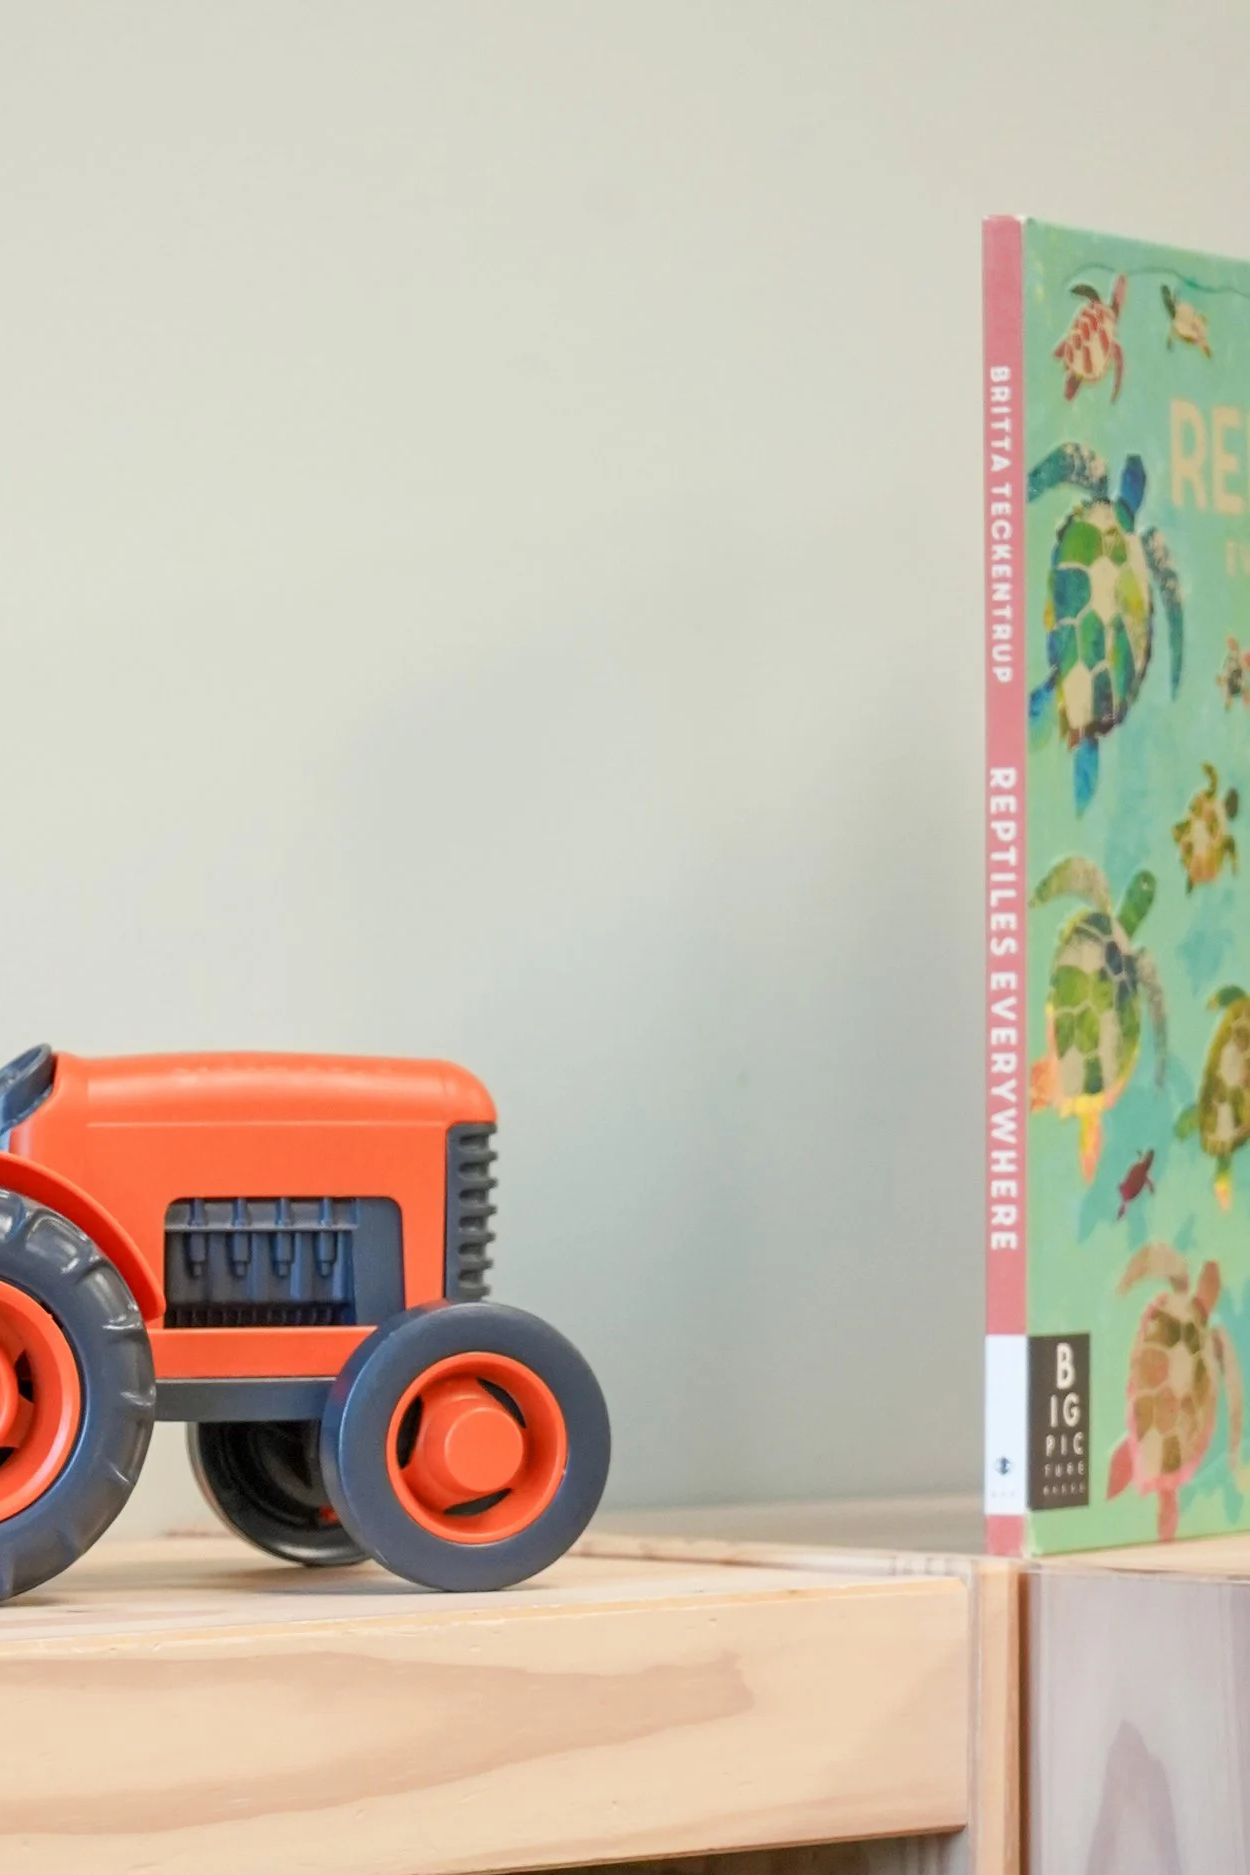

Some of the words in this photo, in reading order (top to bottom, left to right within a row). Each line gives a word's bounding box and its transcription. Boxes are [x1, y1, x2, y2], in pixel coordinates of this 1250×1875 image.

[990, 366, 1012, 472] BRITTA
[1170, 398, 1250, 515] RE
[991, 483, 1013, 683] TECKENTRUP
[989, 767, 1018, 957] REPTILES
[990, 971, 1018, 1250] EVERYWHERE
[1049, 1391, 1081, 1428] IG
[1055, 1342, 1076, 1390] B
[1045, 1431, 1084, 1457] PIC
